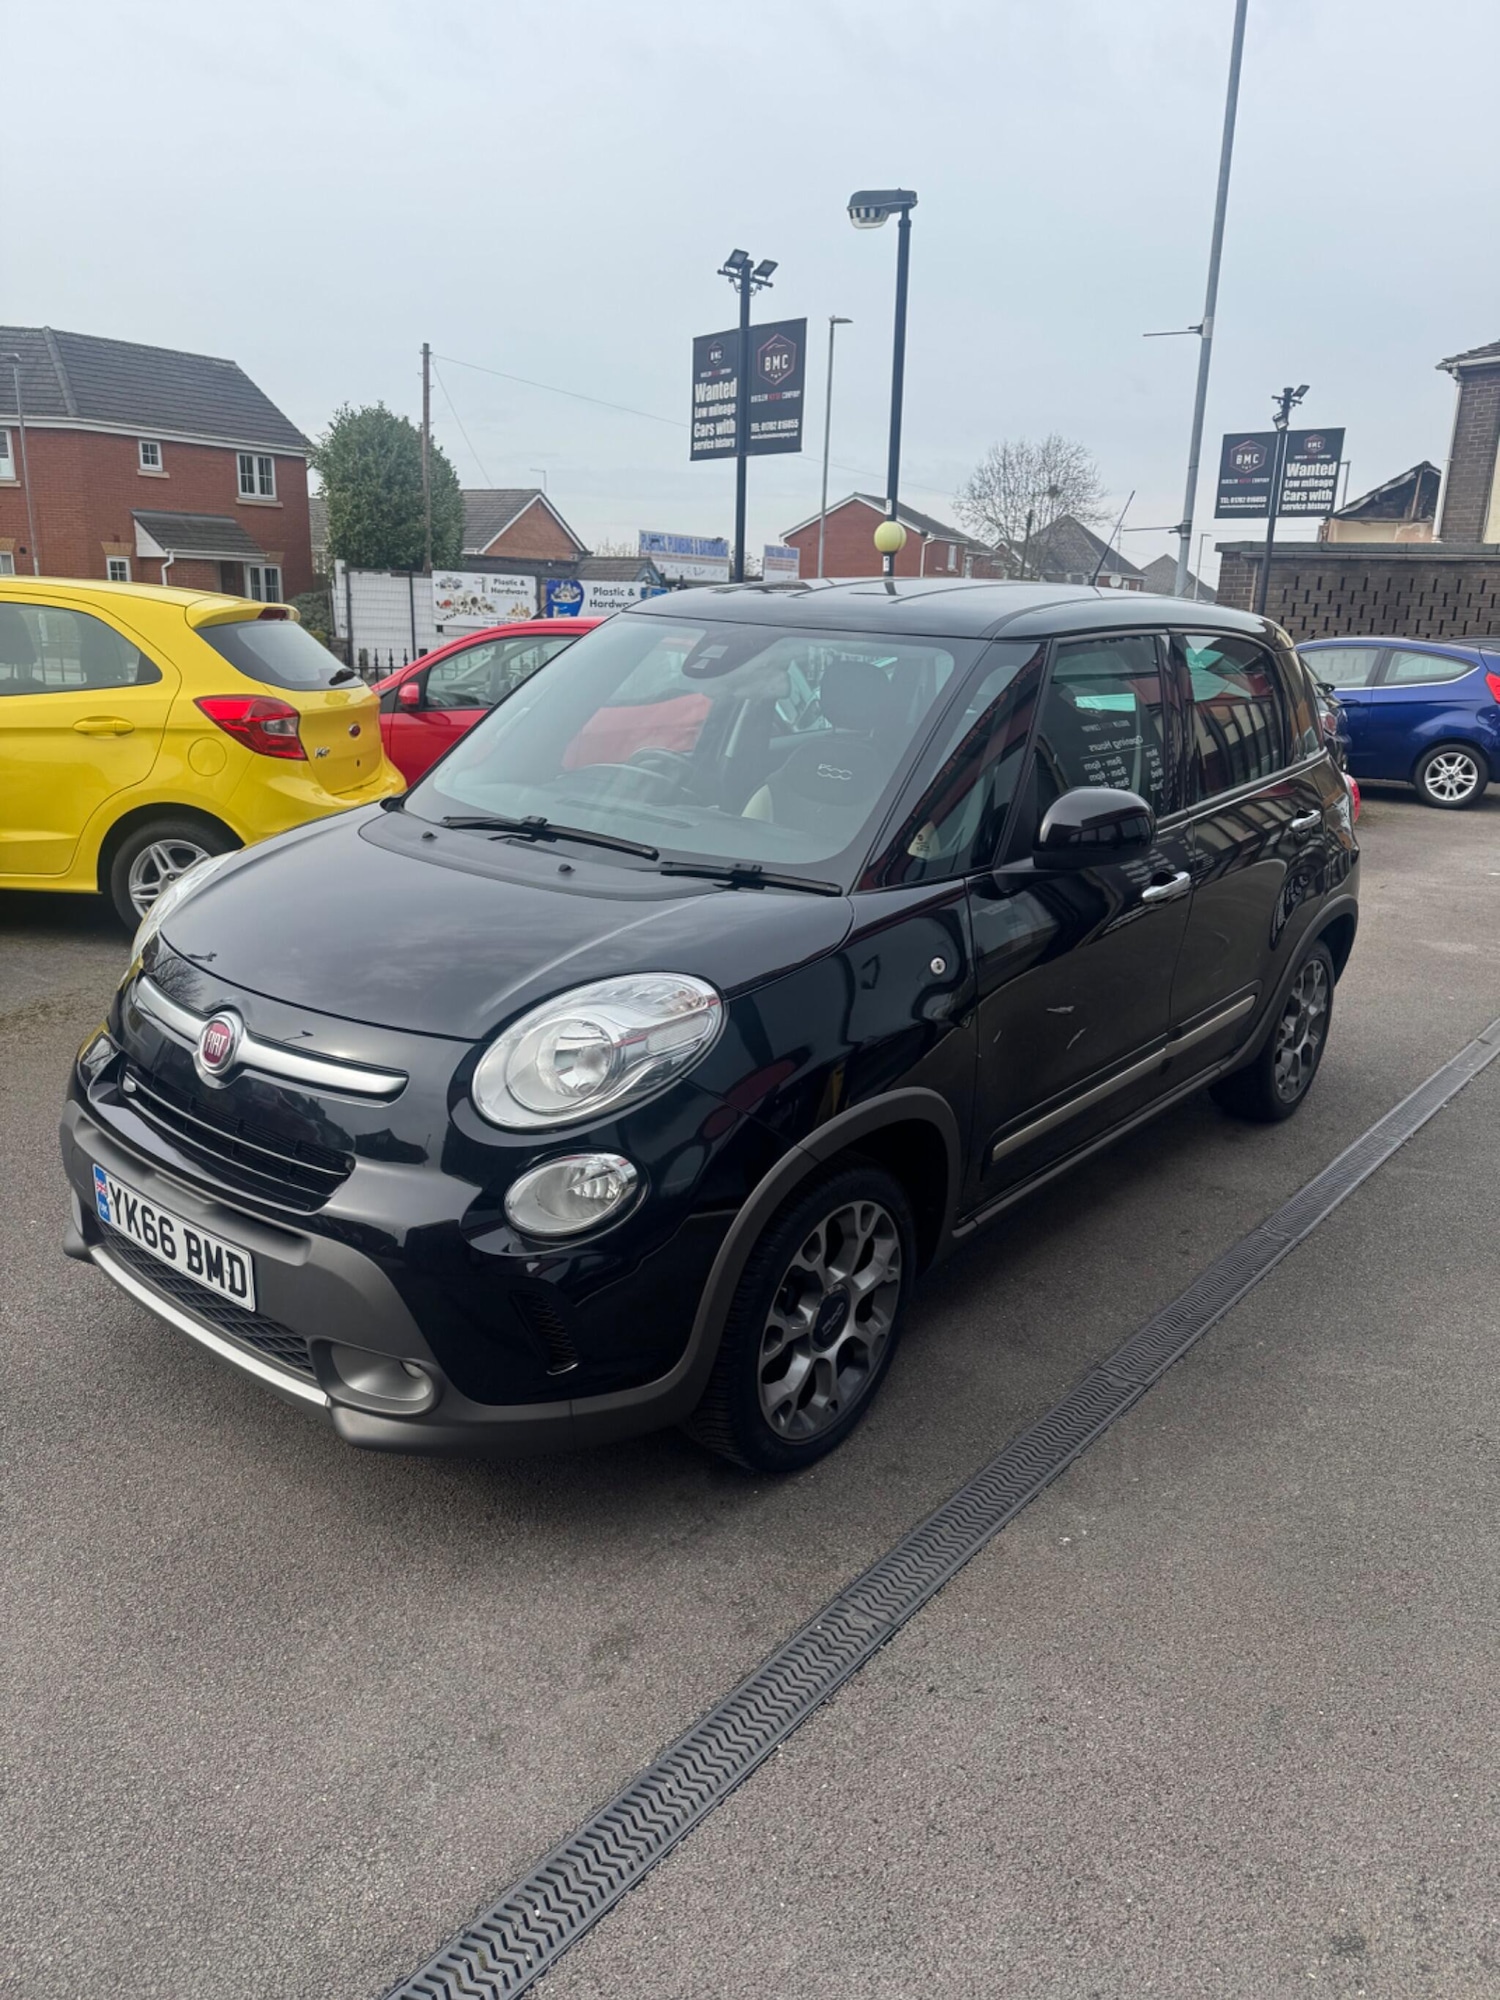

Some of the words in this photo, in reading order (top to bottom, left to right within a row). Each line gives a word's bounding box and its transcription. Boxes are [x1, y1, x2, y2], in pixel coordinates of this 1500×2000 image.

[764, 354, 789, 371] BMC
[695, 377, 737, 403] Wanted
[695, 406, 707, 418] Low
[709, 403, 736, 415] mileage
[694, 422, 715, 438] Cars
[716, 418, 736, 435] with
[693, 440, 714, 451] service
[715, 437, 736, 448] history
[1307, 441, 1322, 449] BMC
[1235, 454, 1260, 465] BMC
[1286, 461, 1338, 478] Wanted
[1284, 479, 1300, 488] Low
[1301, 478, 1334, 489] mileage
[1282, 490, 1308, 502] Cars
[1309, 489, 1333, 501] with
[1281, 503, 1307, 511] service
[1306, 502, 1332, 511] history
[493, 578, 518, 587] Plastic
[491, 587, 529, 596] Hardware
[593, 587, 625, 597] Plastic
[627, 588, 635, 597] &
[205, 1029, 228, 1058] FIAT
[108, 1181, 177, 1261] YK66
[183, 1227, 248, 1299] BMD
